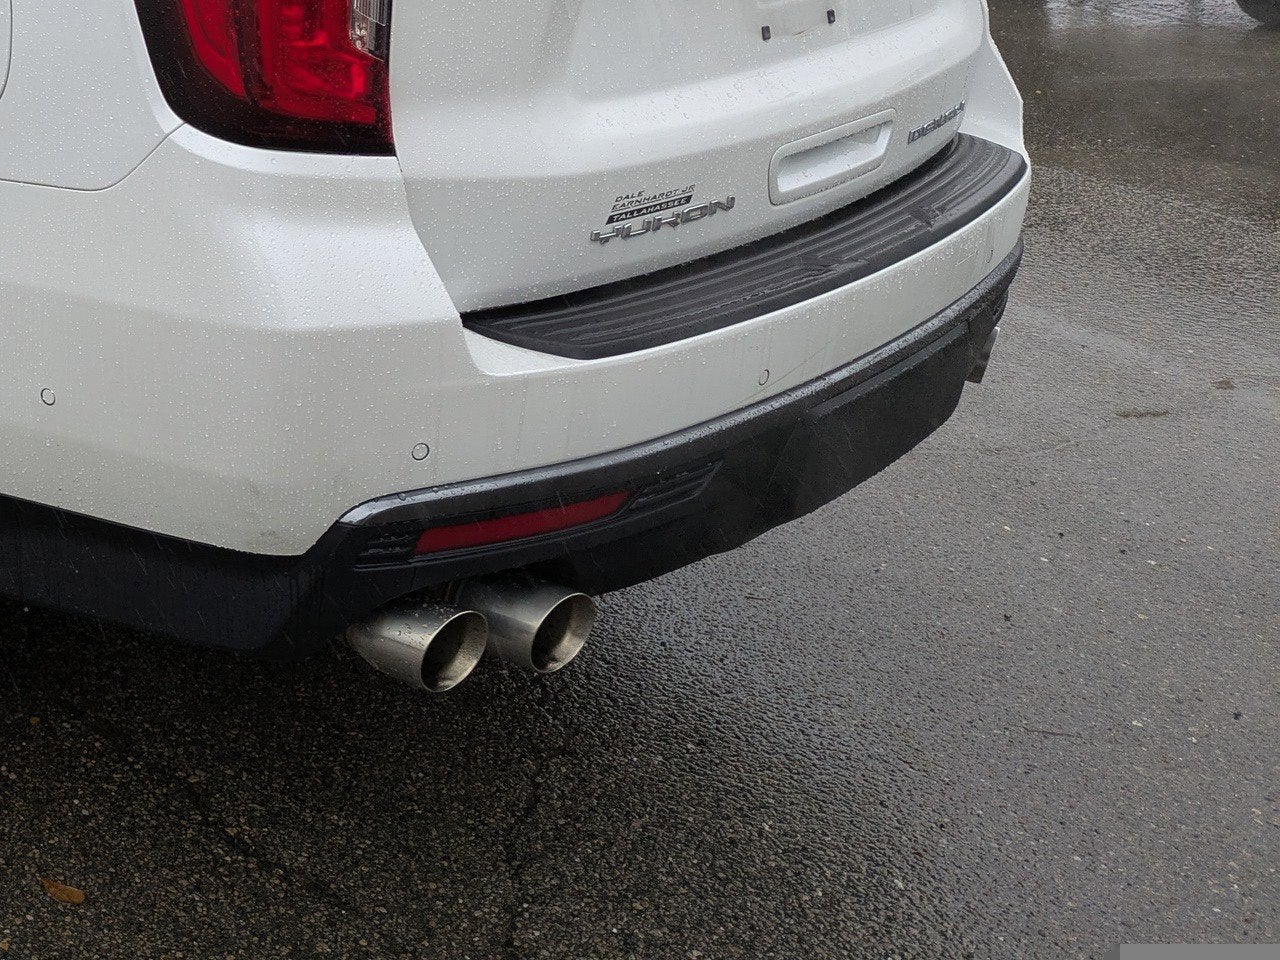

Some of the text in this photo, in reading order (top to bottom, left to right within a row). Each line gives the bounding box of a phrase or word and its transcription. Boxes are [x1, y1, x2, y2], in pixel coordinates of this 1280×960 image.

[611, 185, 696, 211] EARNHARDT JR
[615, 190, 645, 203] DALE
[590, 195, 736, 245] YUKON
[612, 197, 688, 222] TALLAHASSEE
